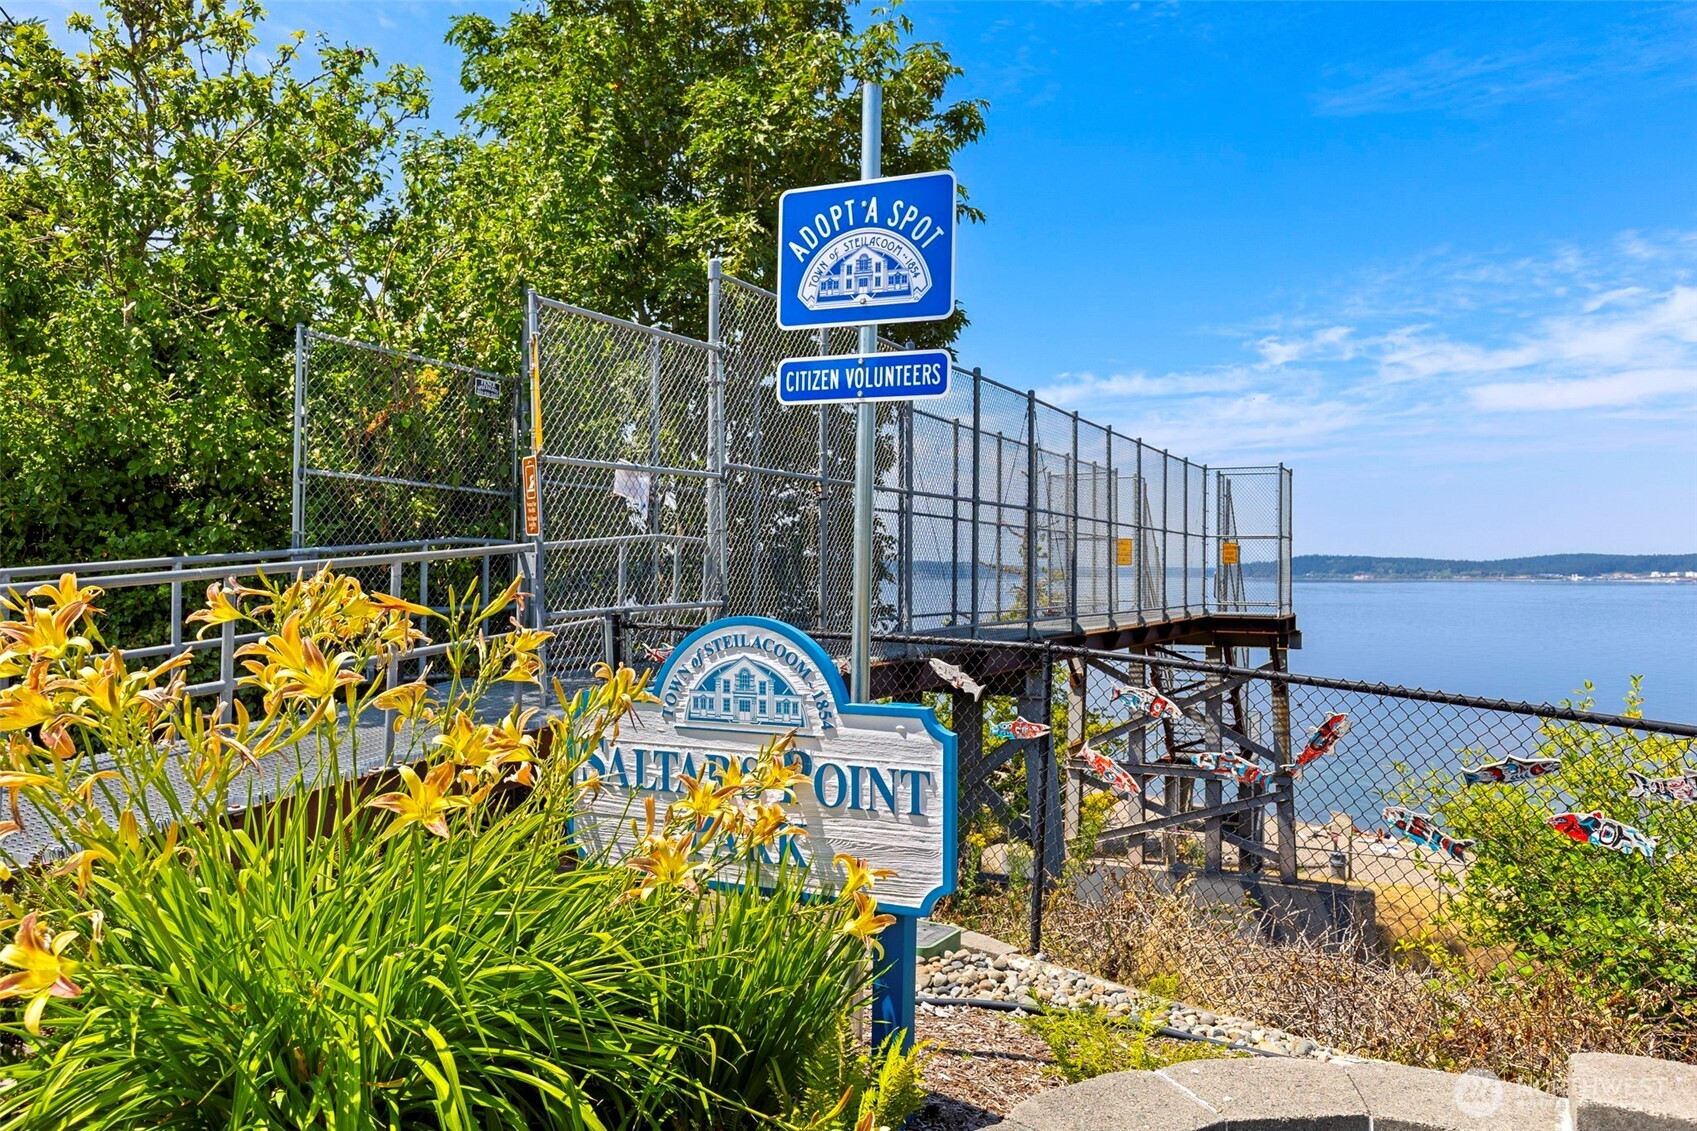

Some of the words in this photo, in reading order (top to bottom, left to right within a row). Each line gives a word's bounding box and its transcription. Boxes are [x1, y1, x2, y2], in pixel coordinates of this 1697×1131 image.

[788, 199, 855, 263] ADOPT
[864, 196, 878, 224] A
[887, 199, 945, 249] SPOT
[808, 260, 829, 288] TOWN
[843, 235, 904, 256] STEILACOOM
[905, 257, 922, 279] 1854
[785, 368, 840, 393] CITIZEN
[845, 363, 942, 390] VOLUNTEERS
[661, 663, 692, 718] TOWN
[690, 647, 703, 669] of
[704, 633, 813, 680] STEILACOOM
[811, 689, 835, 731] 1854
[780, 749, 931, 816] POINT
